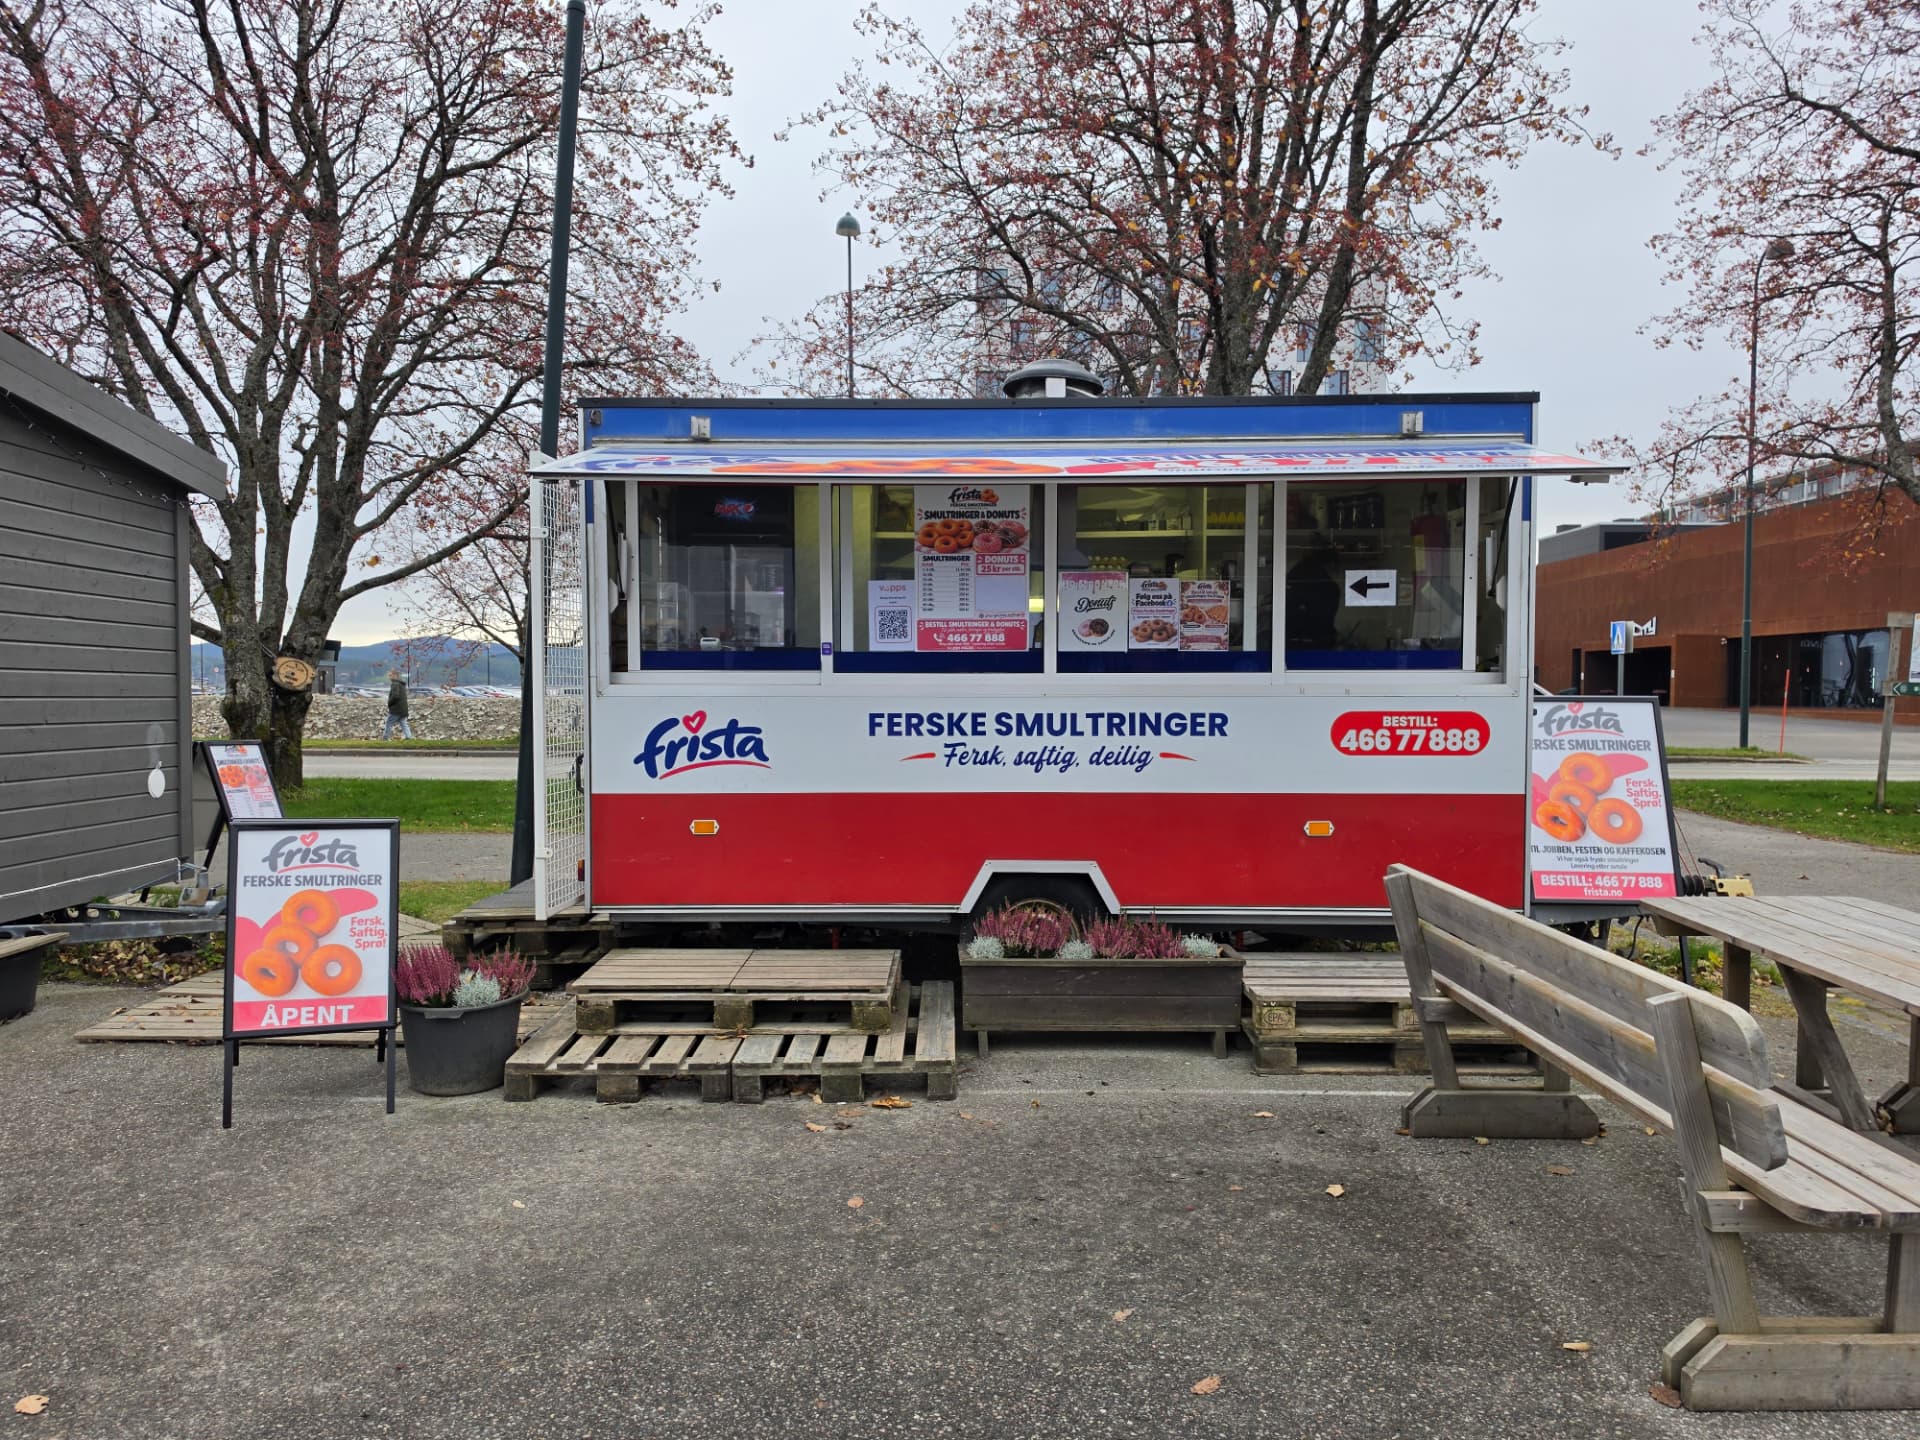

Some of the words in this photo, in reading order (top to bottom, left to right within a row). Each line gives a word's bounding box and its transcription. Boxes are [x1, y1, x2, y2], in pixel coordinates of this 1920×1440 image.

[1084, 453, 1227, 464] BESTILL
[1244, 451, 1512, 459] SMULTRINGER
[1153, 459, 1279, 469] 466
[948, 488, 982, 503] frista
[924, 511, 979, 519] SMULTRINGER
[986, 511, 1020, 519] DONUTS
[982, 565, 992, 573] 25
[1074, 595, 1117, 612] Donuts
[947, 634, 967, 642] 466
[969, 634, 982, 642] 77
[985, 634, 1005, 642] 888
[868, 712, 987, 737] FERSKE
[994, 711, 1230, 737] SMULTRINGER
[1382, 716, 1438, 727] BESTILL:
[1538, 703, 1624, 736] frista
[634, 711, 770, 779] frista
[1340, 729, 1391, 752] 466
[1395, 729, 1427, 752] 77
[1429, 729, 1480, 752] 888
[1532, 739, 1566, 751] RSKE
[1568, 739, 1651, 752] SMULTRINGER
[943, 742, 1006, 768] Fersk,
[1013, 745, 1080, 773] saftig,
[1089, 745, 1154, 773] deilig
[1625, 778, 1658, 788] Fersk.
[1626, 788, 1662, 800] Saftig.
[1633, 798, 1662, 809] Sprø!
[261, 834, 360, 872] frista
[1576, 846, 1603, 854] FESTEN
[1616, 848, 1666, 856] KAFFEKOSEN
[243, 875, 292, 887] FERSKE
[294, 875, 382, 887] SMULTRINGER
[1541, 874, 1593, 887] BESTILL:
[1595, 876, 1619, 888] 466
[1621, 876, 1635, 888] 77
[1638, 876, 1662, 888] 888
[1584, 888, 1623, 897] frista.no
[350, 916, 385, 926] Fersk.
[349, 926, 388, 940] Saftig.
[354, 938, 386, 950] Sprø!
[260, 1004, 355, 1027] ÅPENT
